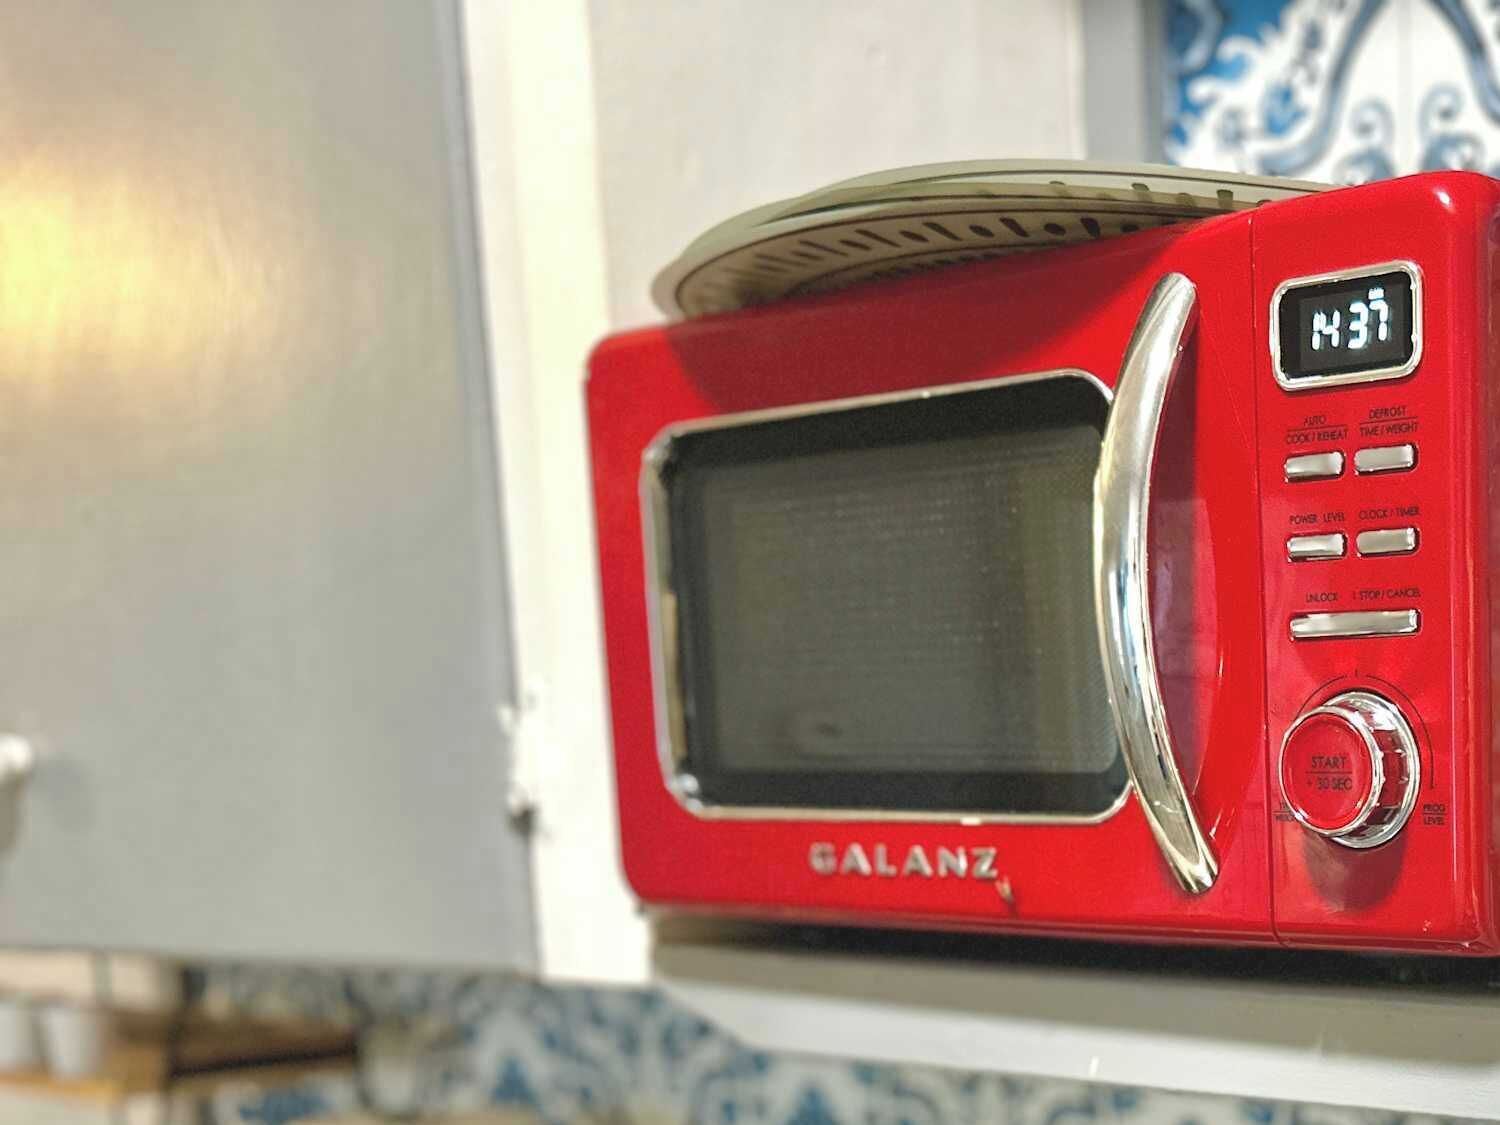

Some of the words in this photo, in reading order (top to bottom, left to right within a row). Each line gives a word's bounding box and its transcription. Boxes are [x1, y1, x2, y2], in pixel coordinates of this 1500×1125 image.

[1369, 406, 1406, 418] DEFROST
[1304, 415, 1327, 427] AUTO
[1359, 510, 1387, 520] CLOCK
[1311, 756, 1347, 768] START
[1333, 776, 1352, 790] SEC
[809, 841, 999, 880] GALANZ
